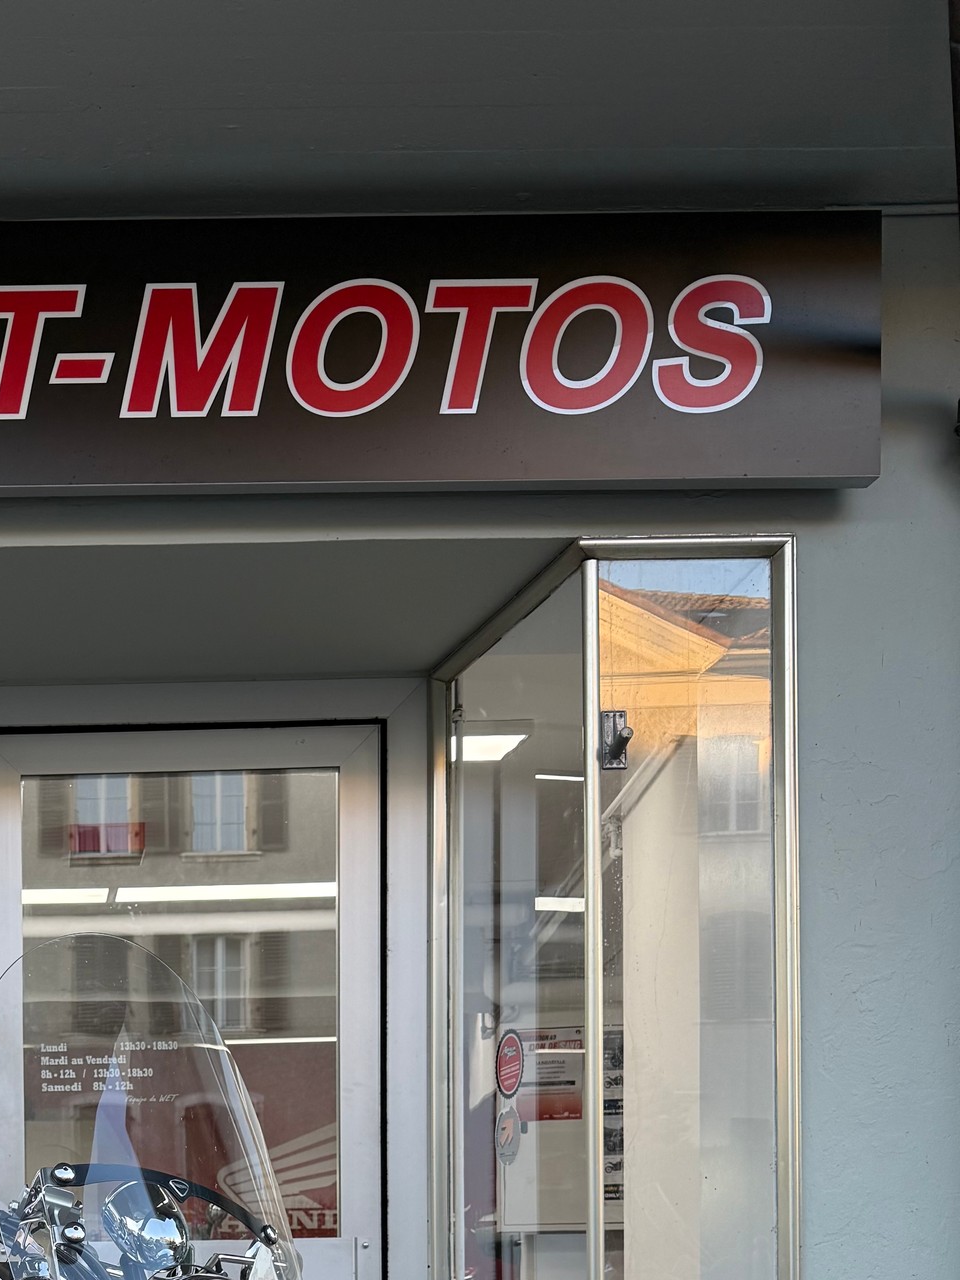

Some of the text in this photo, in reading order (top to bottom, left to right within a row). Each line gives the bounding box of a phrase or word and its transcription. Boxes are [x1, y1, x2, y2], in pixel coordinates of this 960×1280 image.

[40, 1043, 67, 1053] Lundi
[40, 1055, 127, 1066] Mardi au Vendredi
[41, 1081, 82, 1092] Samedi
